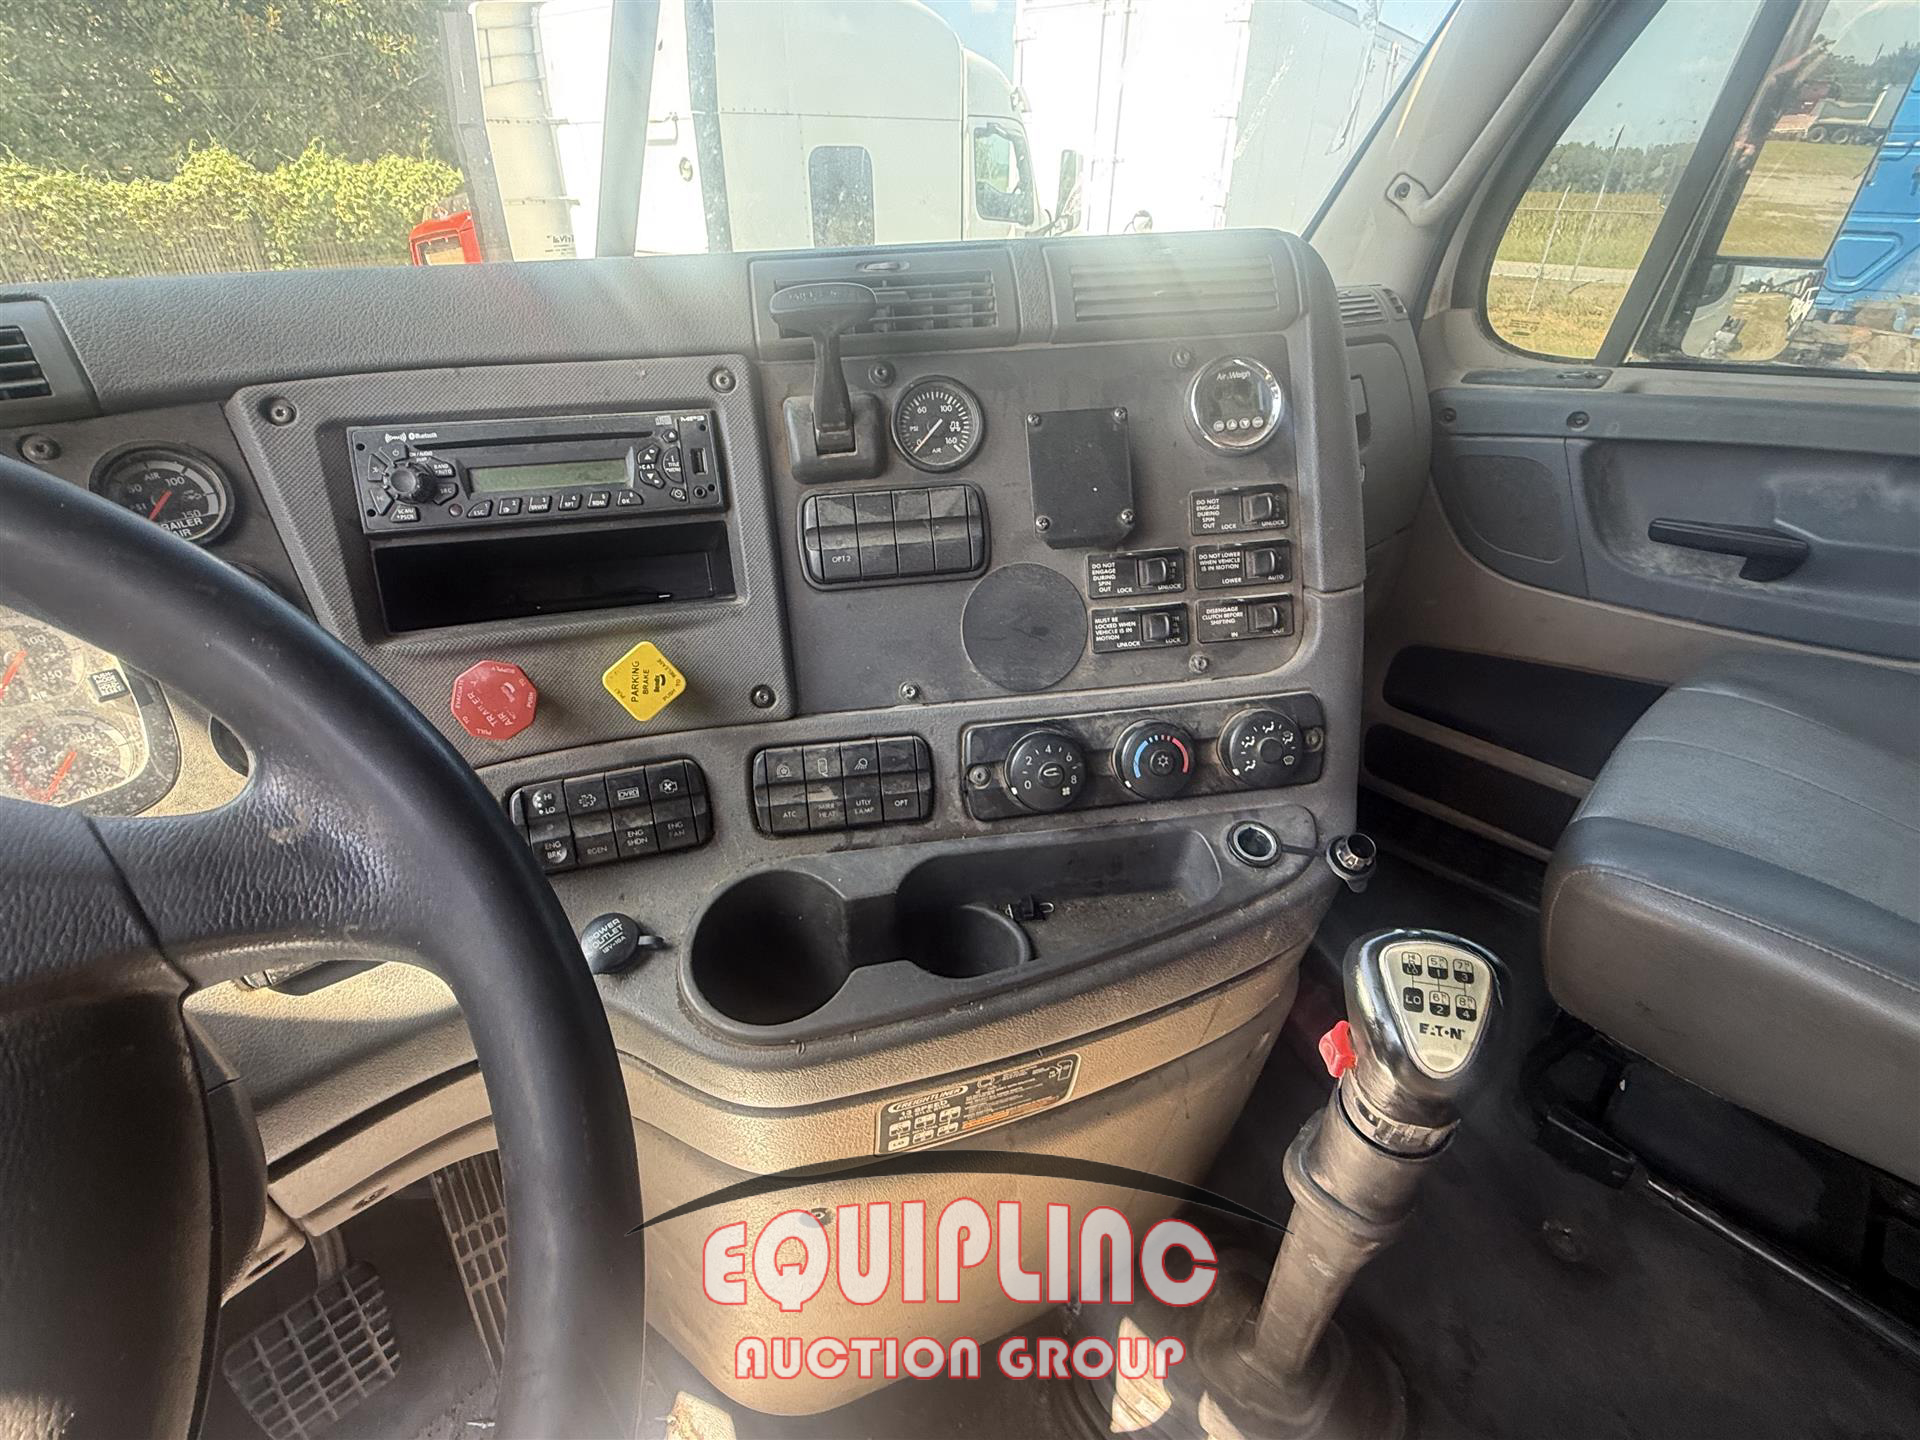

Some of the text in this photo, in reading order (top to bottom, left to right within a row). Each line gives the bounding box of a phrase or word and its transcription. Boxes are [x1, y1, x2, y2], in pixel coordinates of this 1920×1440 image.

[917, 406, 927, 414] 60
[145, 472, 160, 481] AIR
[165, 476, 185, 487] 100
[1196, 504, 1219, 512] ENGAGE
[182, 509, 201, 519] 150
[161, 517, 203, 530] RAILER
[1262, 519, 1284, 527] UNLOCK
[1206, 606, 1238, 614] DISENGAGE
[1202, 612, 1222, 620] CLUTCH
[630, 660, 640, 703] PARKING
[642, 668, 650, 695] BRAKE
[30, 691, 49, 702] AIR
[662, 688, 676, 702] PUSH
[498, 711, 513, 726] AIR
[476, 728, 493, 736] PULL
[1044, 744, 1052, 754] 4
[1025, 755, 1032, 766] 2
[1066, 752, 1073, 762] 6
[1071, 774, 1077, 784] 8
[1024, 780, 1032, 790] 0
[79, 787, 97, 798] AIR
[543, 793, 552, 801] HI
[545, 807, 555, 815] LO
[855, 807, 874, 815] LAMP
[667, 821, 684, 830] ENG
[545, 841, 561, 850] ENG
[627, 838, 648, 847] SHDN
[547, 851, 561, 859] BRK
[587, 846, 607, 855] RGEN
[588, 918, 620, 944] POWER
[592, 923, 623, 949] OUTLET
[1461, 973, 1469, 981] 3
[1405, 994, 1422, 1005] LO
[1437, 1005, 1443, 1014] 2
[1462, 1010, 1470, 1018] 4
[896, 1087, 962, 1110] FREIGHTLINER
[913, 1100, 948, 1114] SPEED
